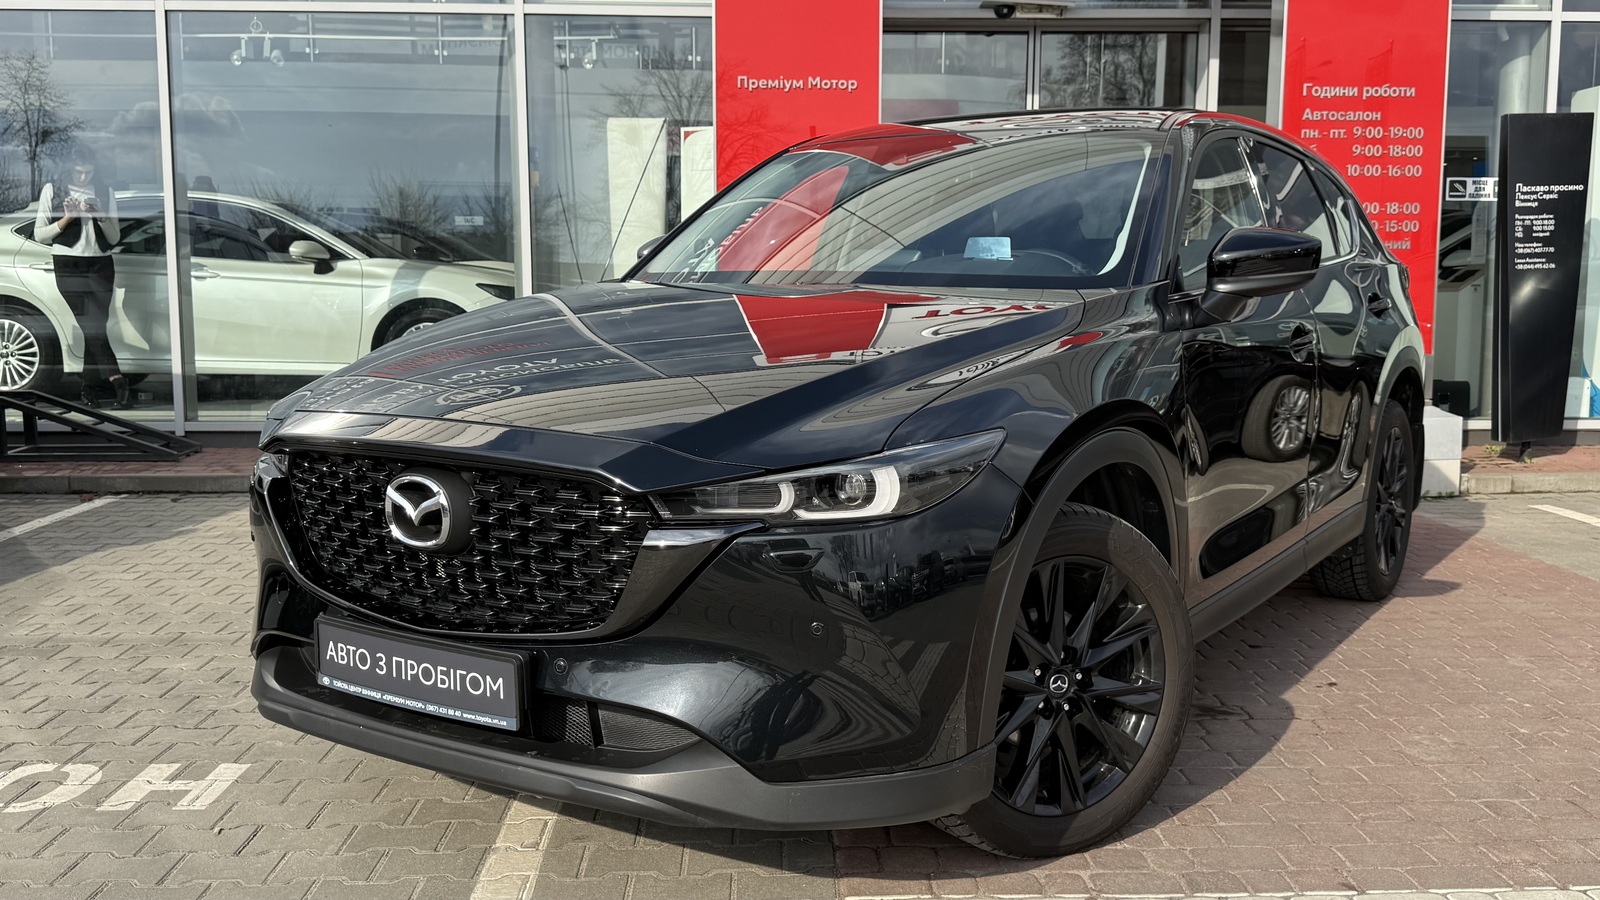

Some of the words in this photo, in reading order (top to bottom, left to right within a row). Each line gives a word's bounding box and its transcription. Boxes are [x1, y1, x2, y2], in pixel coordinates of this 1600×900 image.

[737, 76, 804, 92] Преміум
[808, 76, 858, 92] Мотор
[1302, 83, 1358, 98] Години
[1362, 84, 1416, 100] роботи
[1302, 108, 1381, 121] Автосалон
[1353, 126, 1424, 139] 9:00-19:00
[1352, 144, 1423, 157] 9:00-18:00
[1346, 164, 1422, 177] 10:00-16:00
[1515, 183, 1549, 192] Ласкаво
[1550, 184, 1584, 192] просимо
[326, 640, 371, 670] АВТО
[392, 656, 504, 700] ПРОБІГОМ
